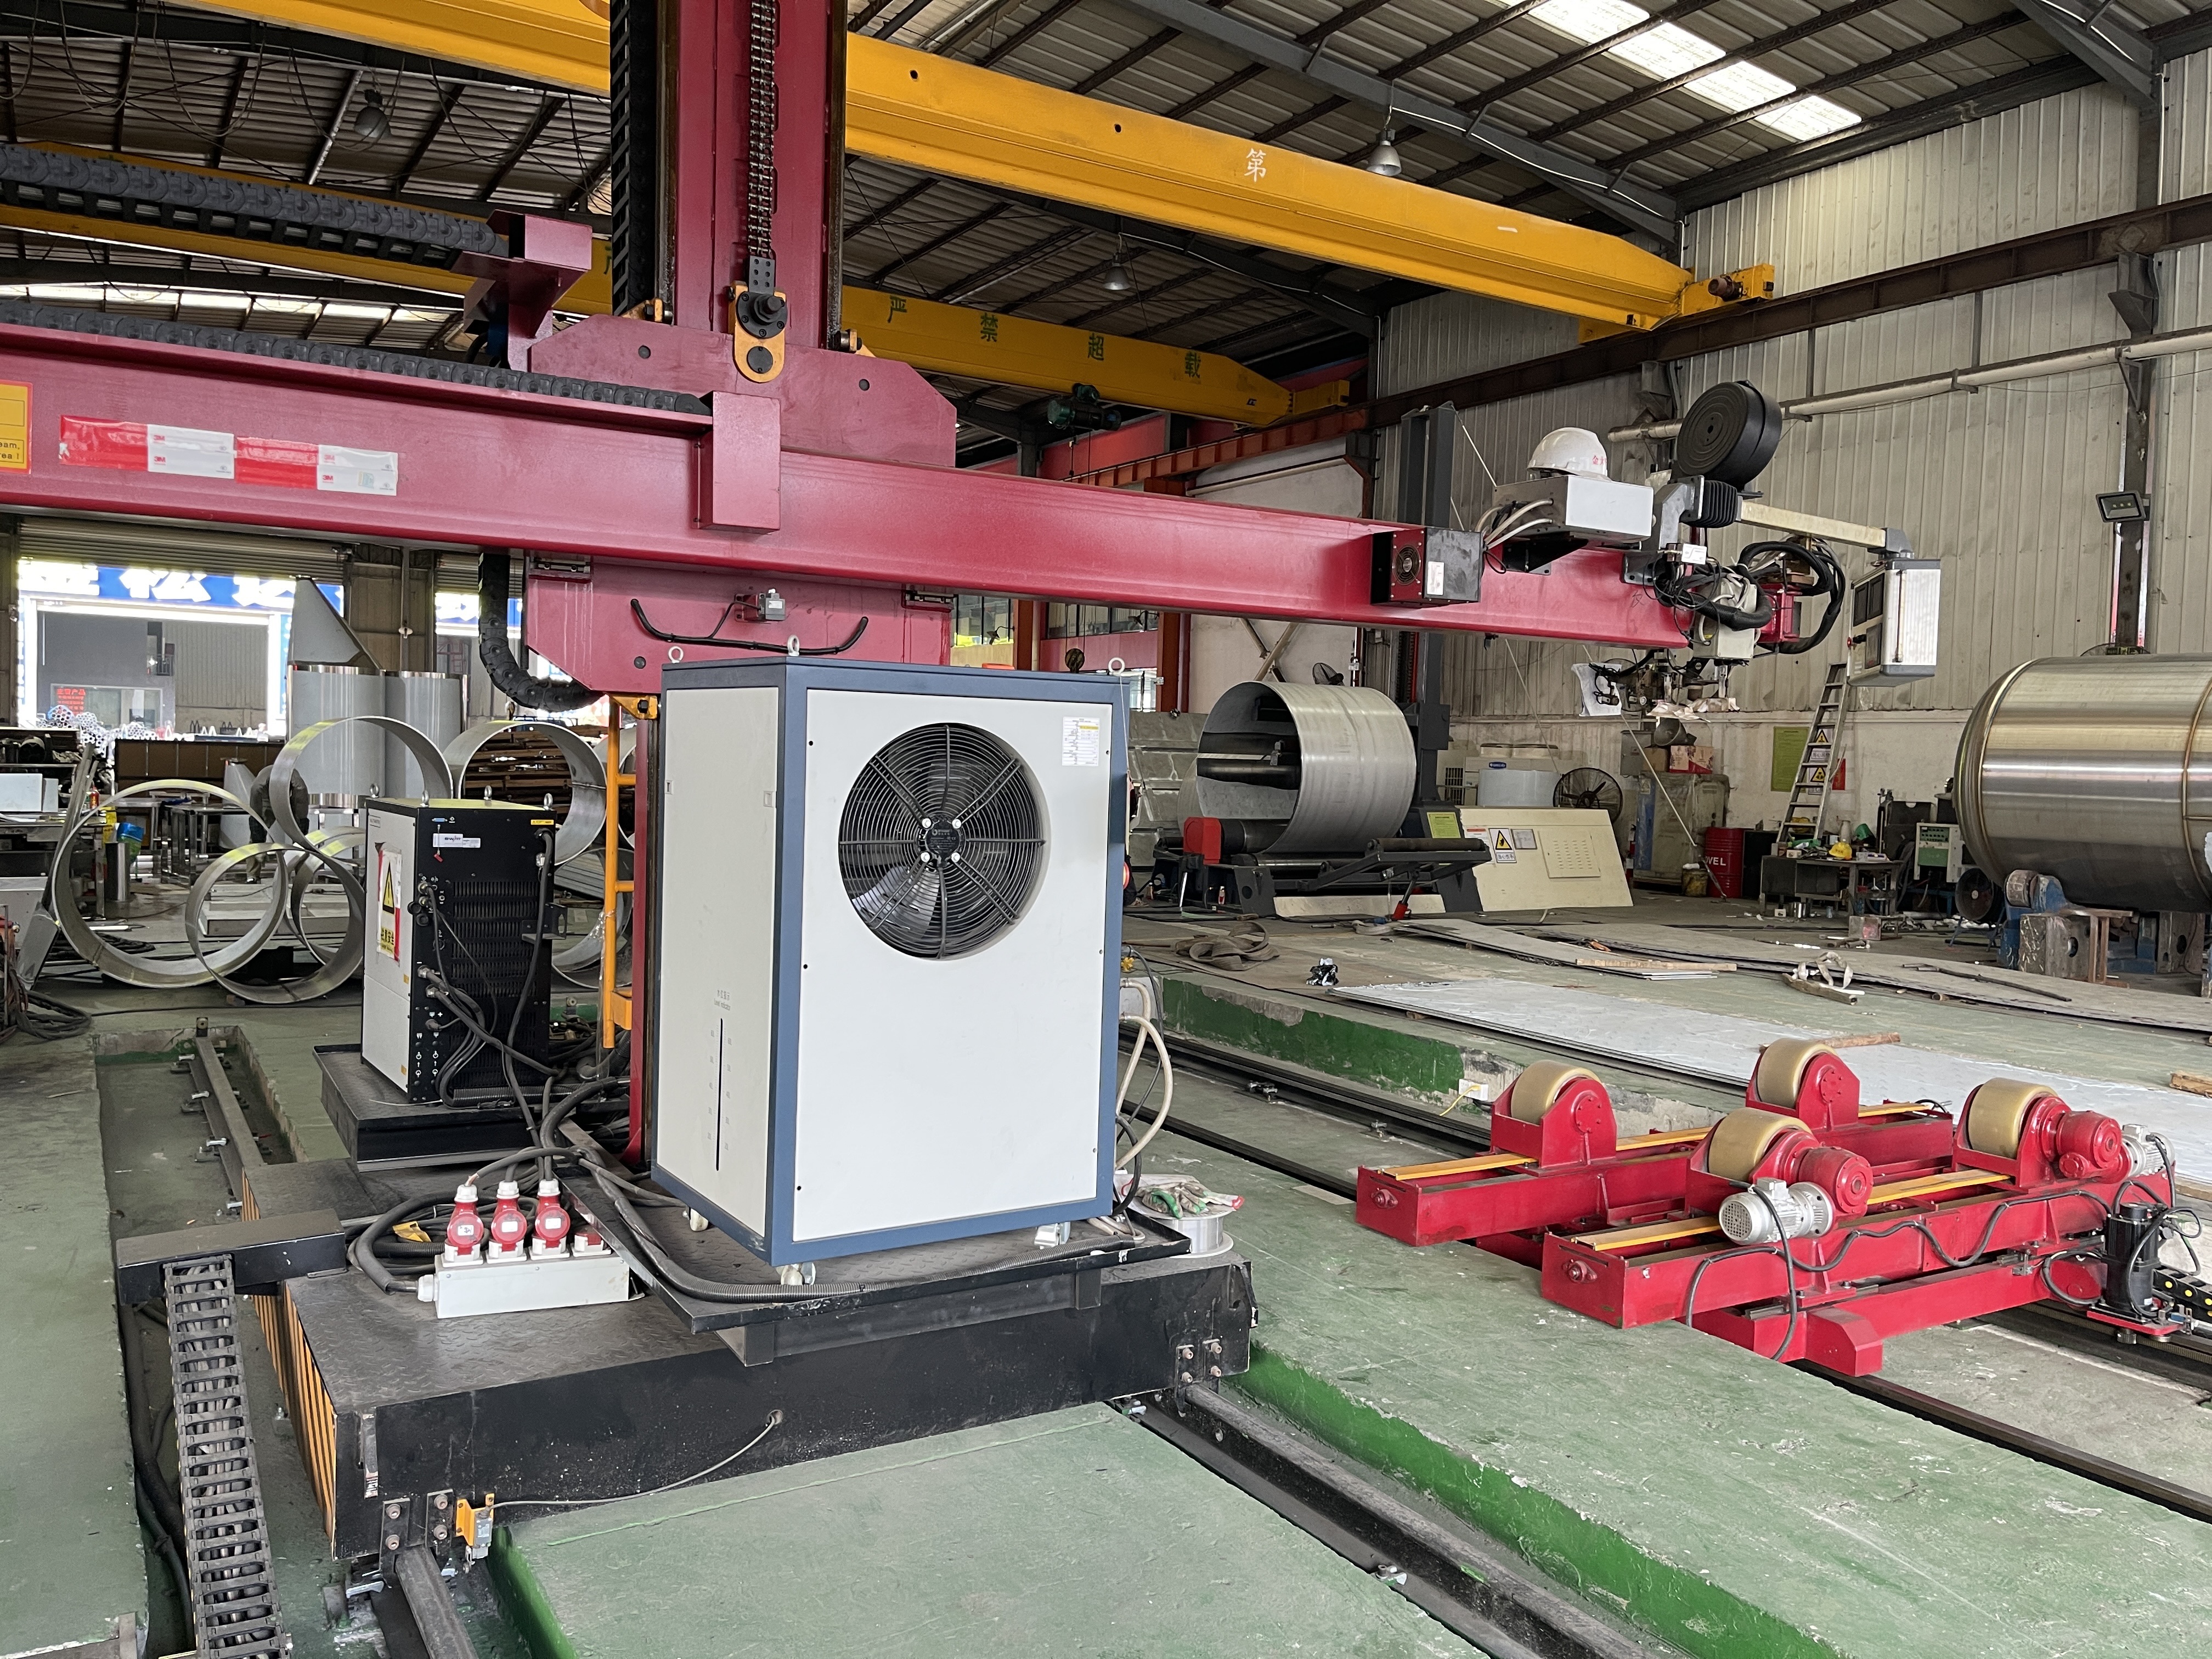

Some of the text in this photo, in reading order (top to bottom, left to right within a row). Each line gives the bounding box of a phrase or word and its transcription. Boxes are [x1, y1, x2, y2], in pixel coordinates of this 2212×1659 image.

[1244, 147, 1267, 182] 第
[887, 295, 1201, 379] 严 禁 超 载
